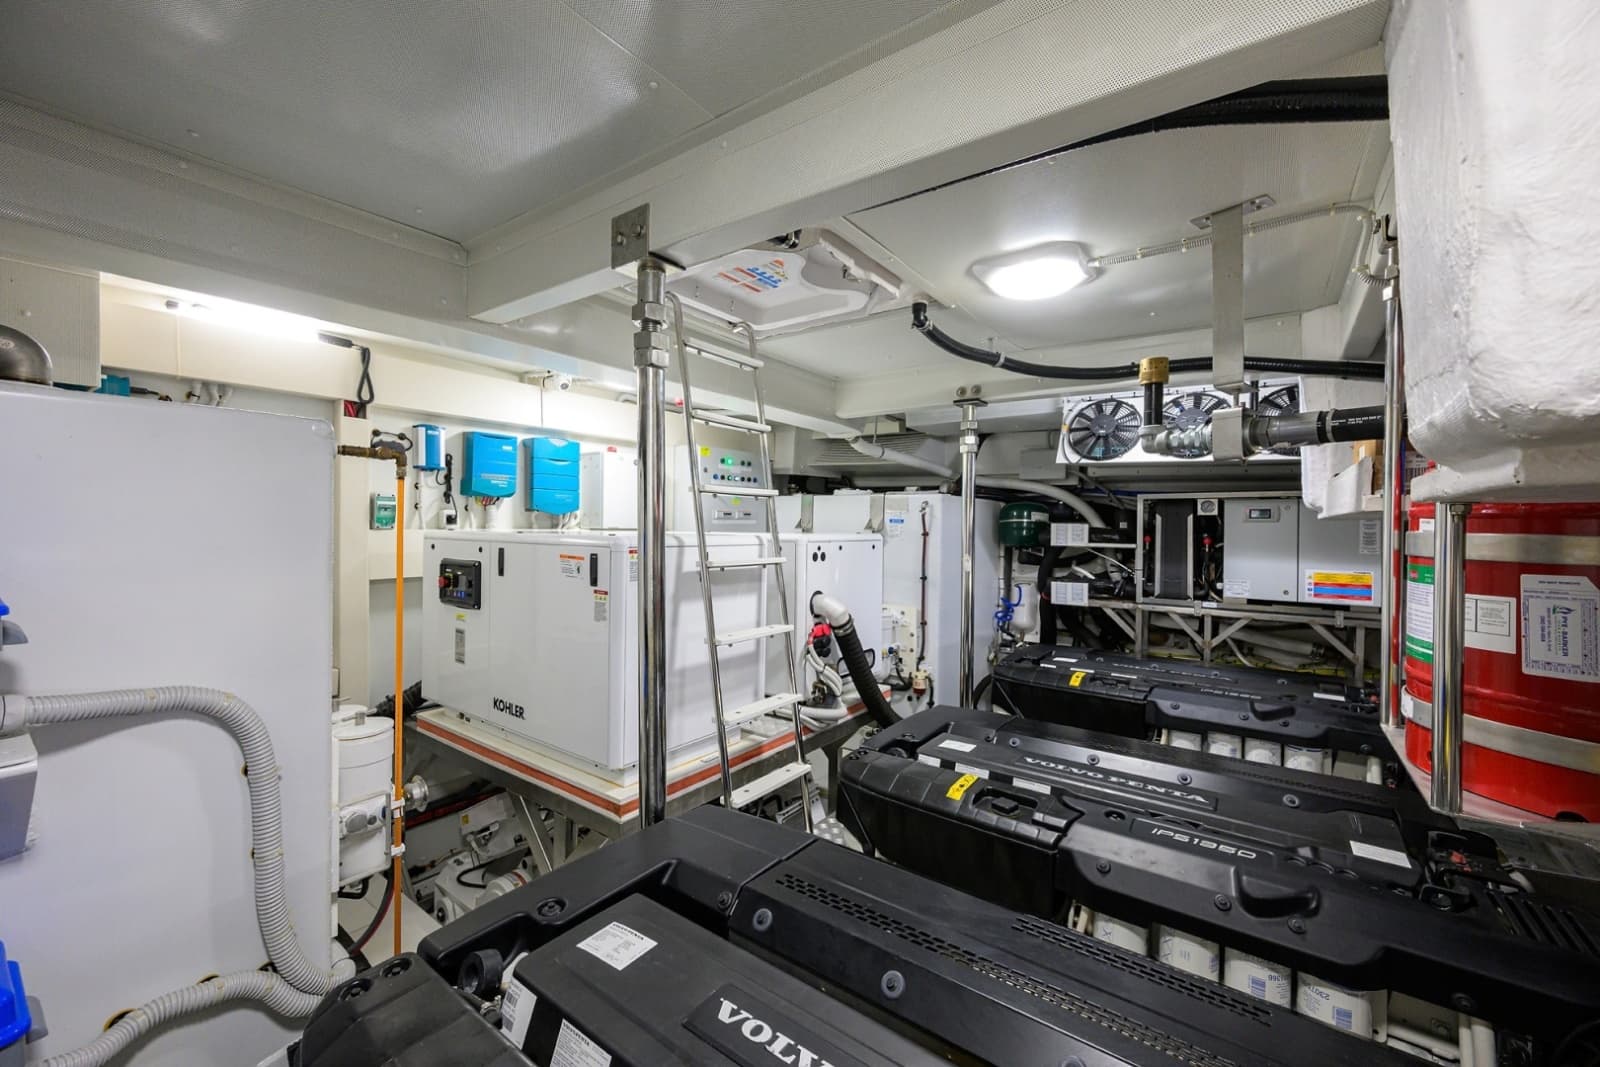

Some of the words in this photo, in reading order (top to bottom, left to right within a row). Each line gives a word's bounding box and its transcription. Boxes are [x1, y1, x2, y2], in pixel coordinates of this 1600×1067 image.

[493, 696, 526, 720] KOHLER
[1024, 756, 1104, 779] VOLVO
[1107, 775, 1210, 804] PENTA
